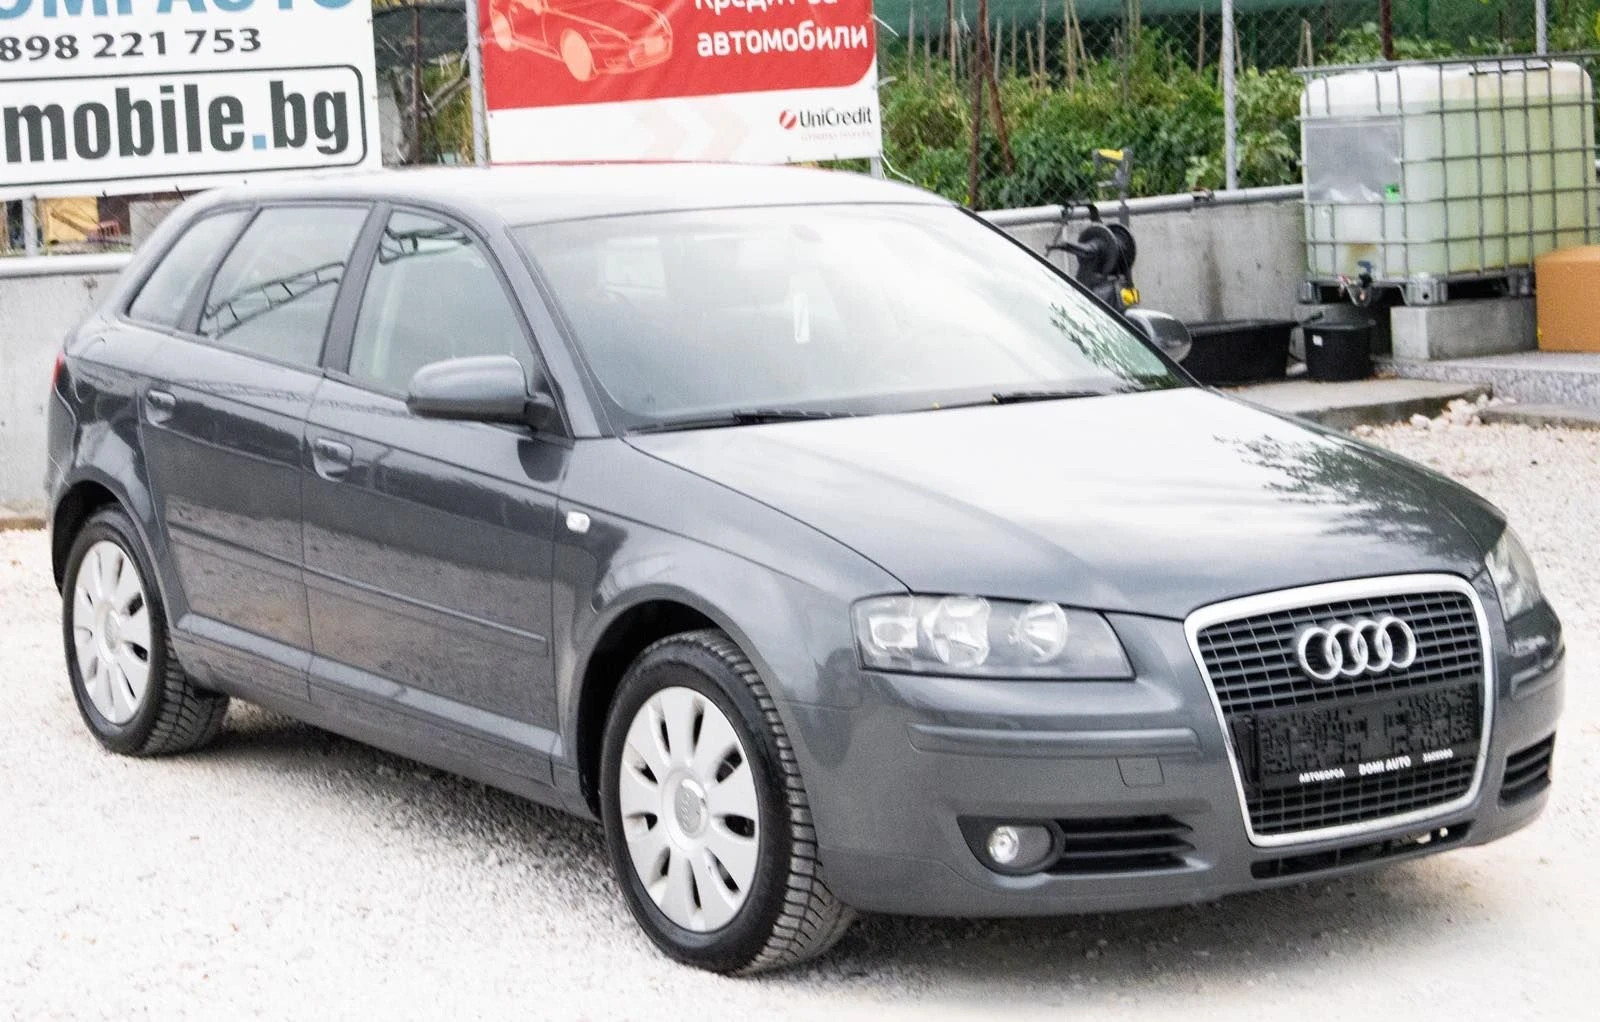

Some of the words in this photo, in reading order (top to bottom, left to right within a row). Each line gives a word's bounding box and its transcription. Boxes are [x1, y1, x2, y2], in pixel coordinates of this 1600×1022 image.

[0, 35, 79, 61] 898
[93, 31, 167, 57] 221
[184, 28, 261, 54] 753
[697, 20, 868, 57] автомобили
[3, 80, 349, 162] mobile.bg
[800, 106, 872, 128] UniCredit
[1385, 755, 1411, 771] AUTO
